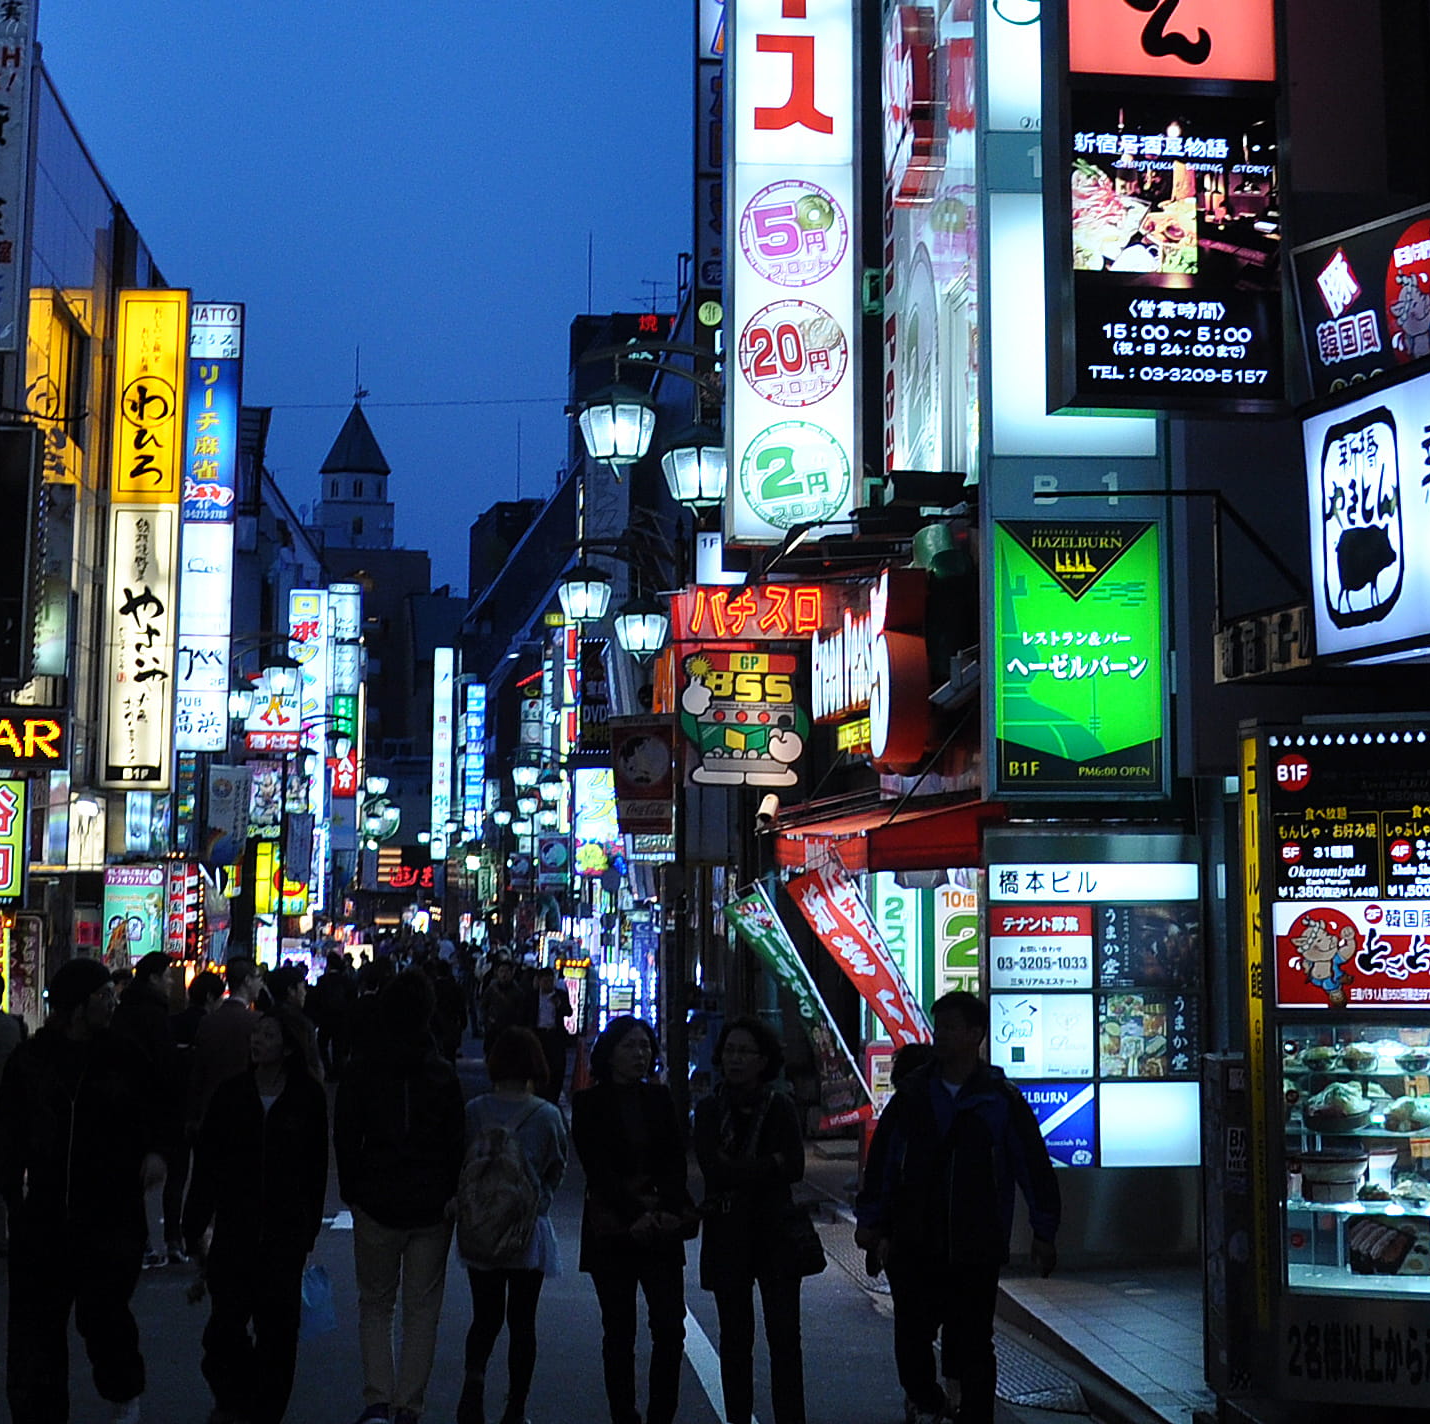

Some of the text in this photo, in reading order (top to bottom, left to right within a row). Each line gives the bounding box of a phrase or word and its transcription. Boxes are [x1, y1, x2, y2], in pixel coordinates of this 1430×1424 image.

[1073, 131, 1229, 160] 新宿居酒屋物語
[192, 364, 221, 481] リーチ麻雀
[1338, 428, 1379, 473] 新橋
[1325, 464, 1398, 528] やきとん
[1030, 536, 1123, 550] HAZELBURN
[690, 585, 823, 638] パチスロ
[739, 655, 760, 670] GP
[1006, 653, 1148, 680] ヘーゼルバーン
[1008, 760, 1041, 777] B1F
[1120, 765, 1151, 776] OPEN
[1276, 763, 1309, 782] B1F
[1390, 844, 1410, 858] 4F
[1287, 864, 1367, 879] Okonomiyaki
[998, 870, 1098, 895] 橋本ビル
[1002, 915, 1079, 933] テナント募集
[1102, 908, 1120, 975] うまか堂
[996, 955, 1088, 971] 03-3205-1033
